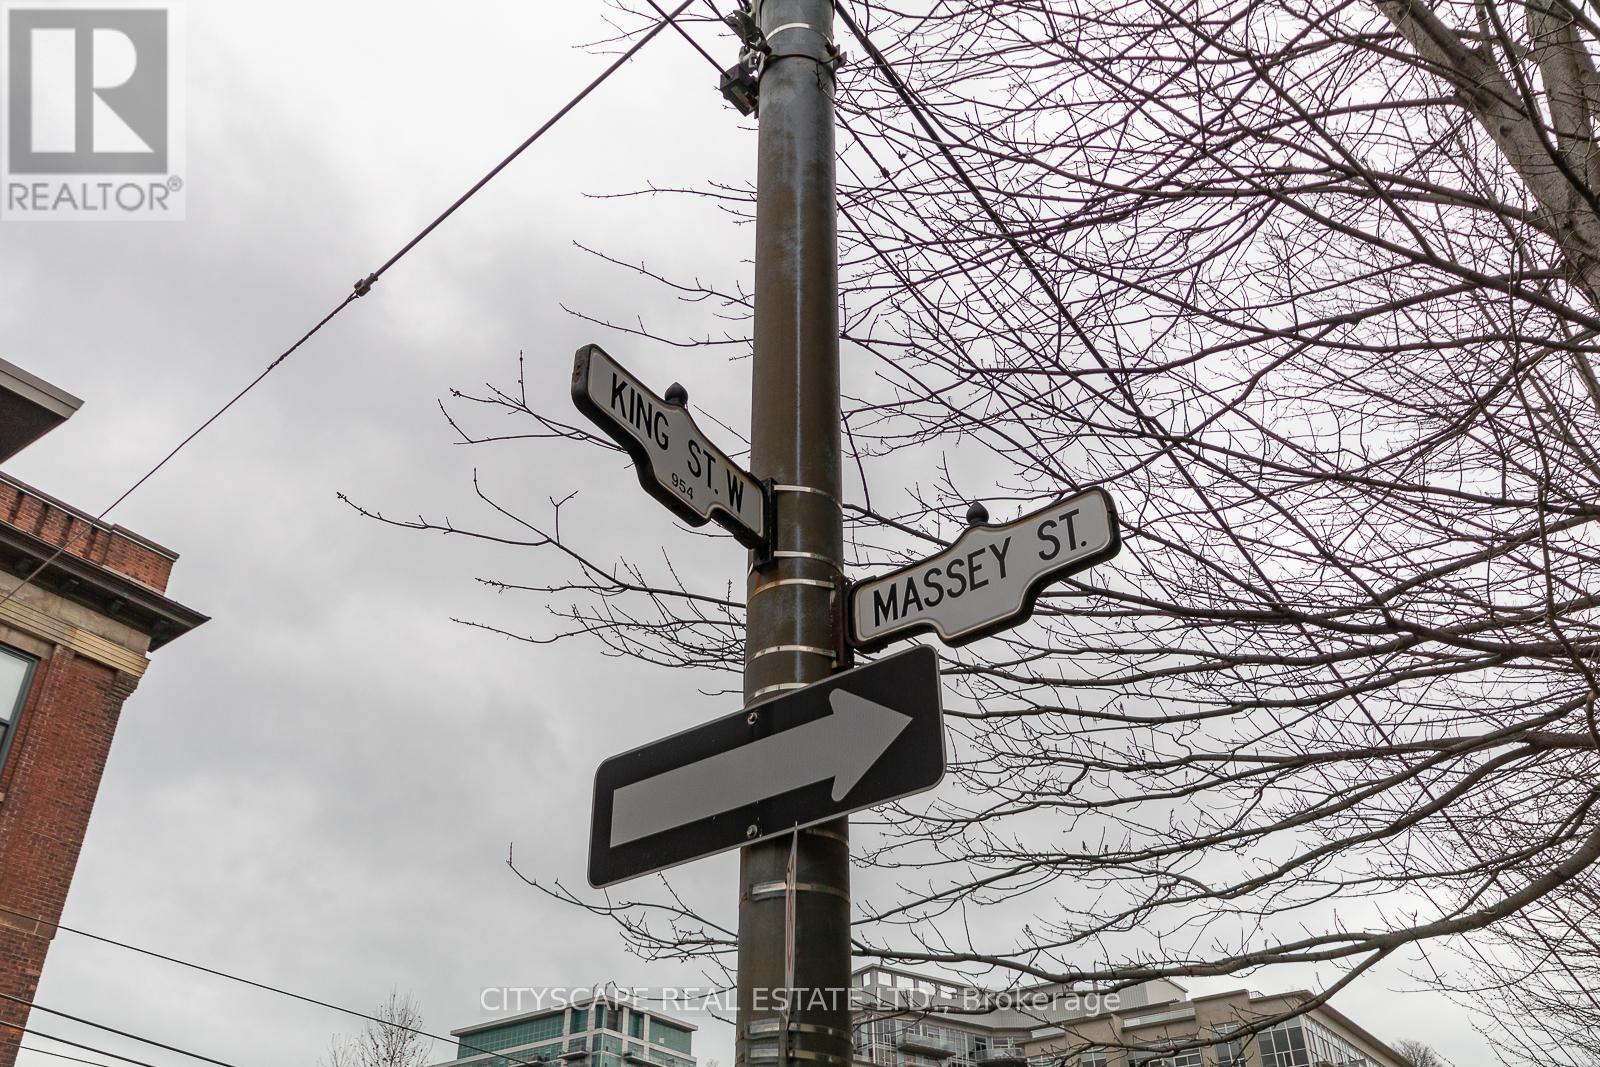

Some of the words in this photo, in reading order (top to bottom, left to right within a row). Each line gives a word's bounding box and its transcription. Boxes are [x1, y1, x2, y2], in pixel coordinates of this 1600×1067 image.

[611, 372, 669, 450] KING
[687, 439, 718, 495] ST.
[726, 469, 744, 513] W
[671, 473, 694, 500] 954
[873, 536, 1012, 627] MASSEY
[1036, 508, 1087, 561] ST.
